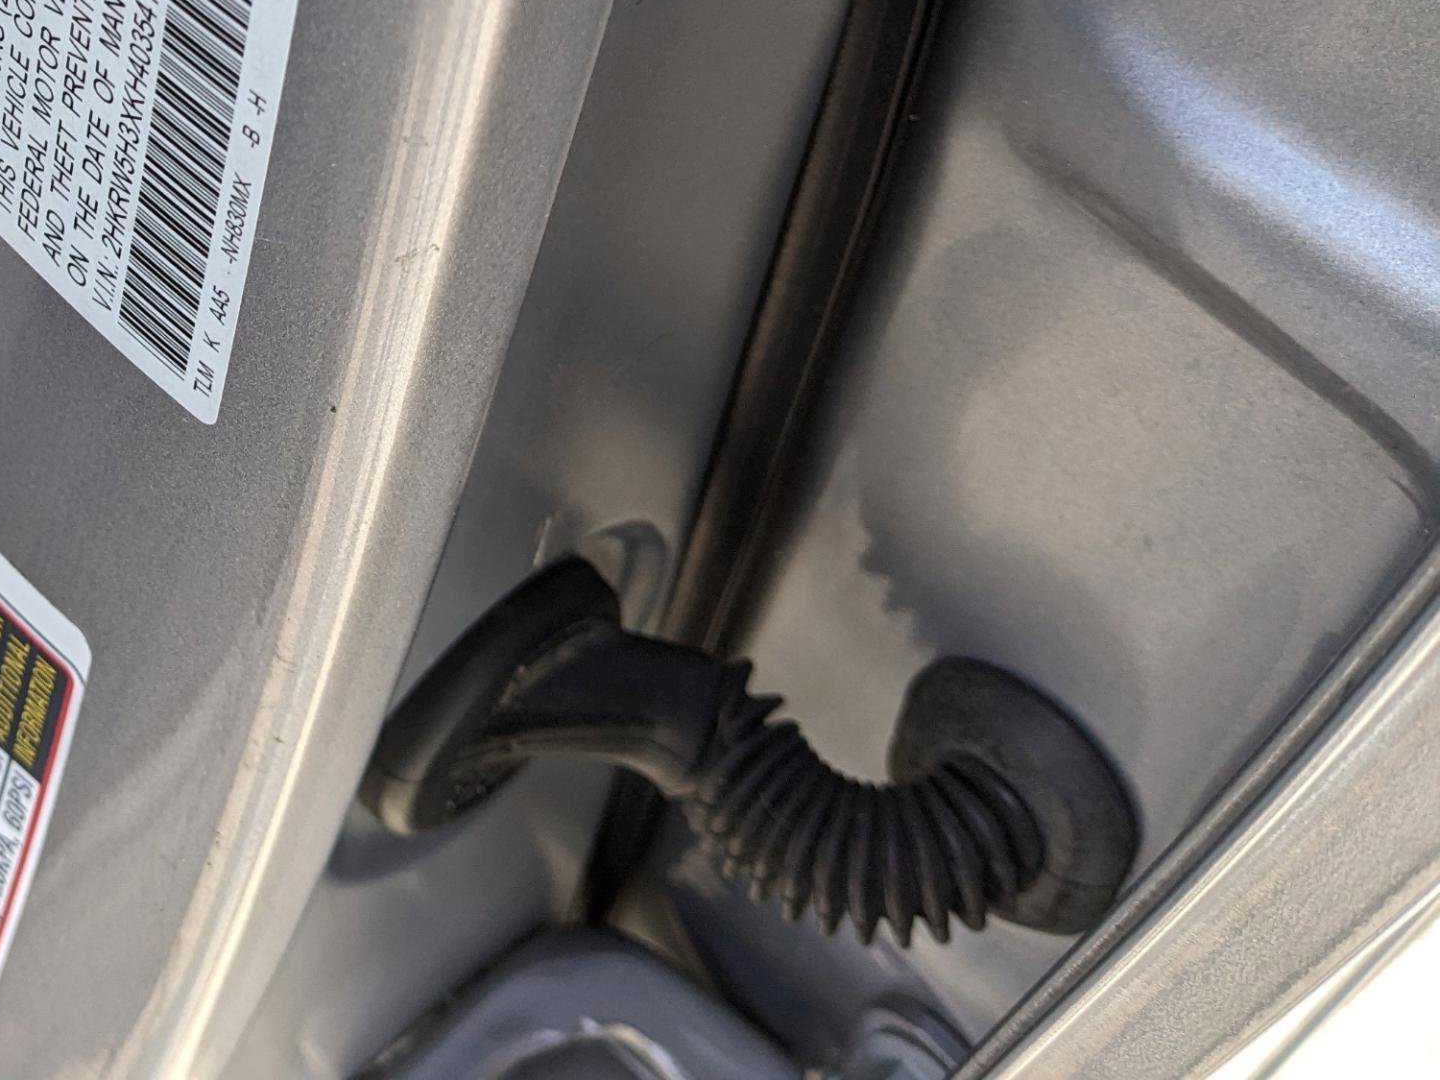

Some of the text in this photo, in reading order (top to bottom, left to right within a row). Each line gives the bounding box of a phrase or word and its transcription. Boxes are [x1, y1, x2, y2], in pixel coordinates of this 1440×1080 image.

[0, 43, 30, 151] VEHICLE
[31, 25, 61, 126] MOTOR
[92, 59, 116, 105] OF
[49, 118, 78, 202] THEFT
[81, 109, 110, 185] DATE
[17, 134, 49, 242] FEDERAL
[73, 186, 99, 240] THE
[220, 171, 252, 265] -NH830MX
[42, 209, 65, 267] AND
[66, 244, 90, 287] ON
[208, 284, 230, 326] AA5
[202, 331, 221, 353] K
[192, 359, 215, 398] TLM
[13, 654, 58, 767] INFORMATION
[2, 770, 34, 832] 60PSI
